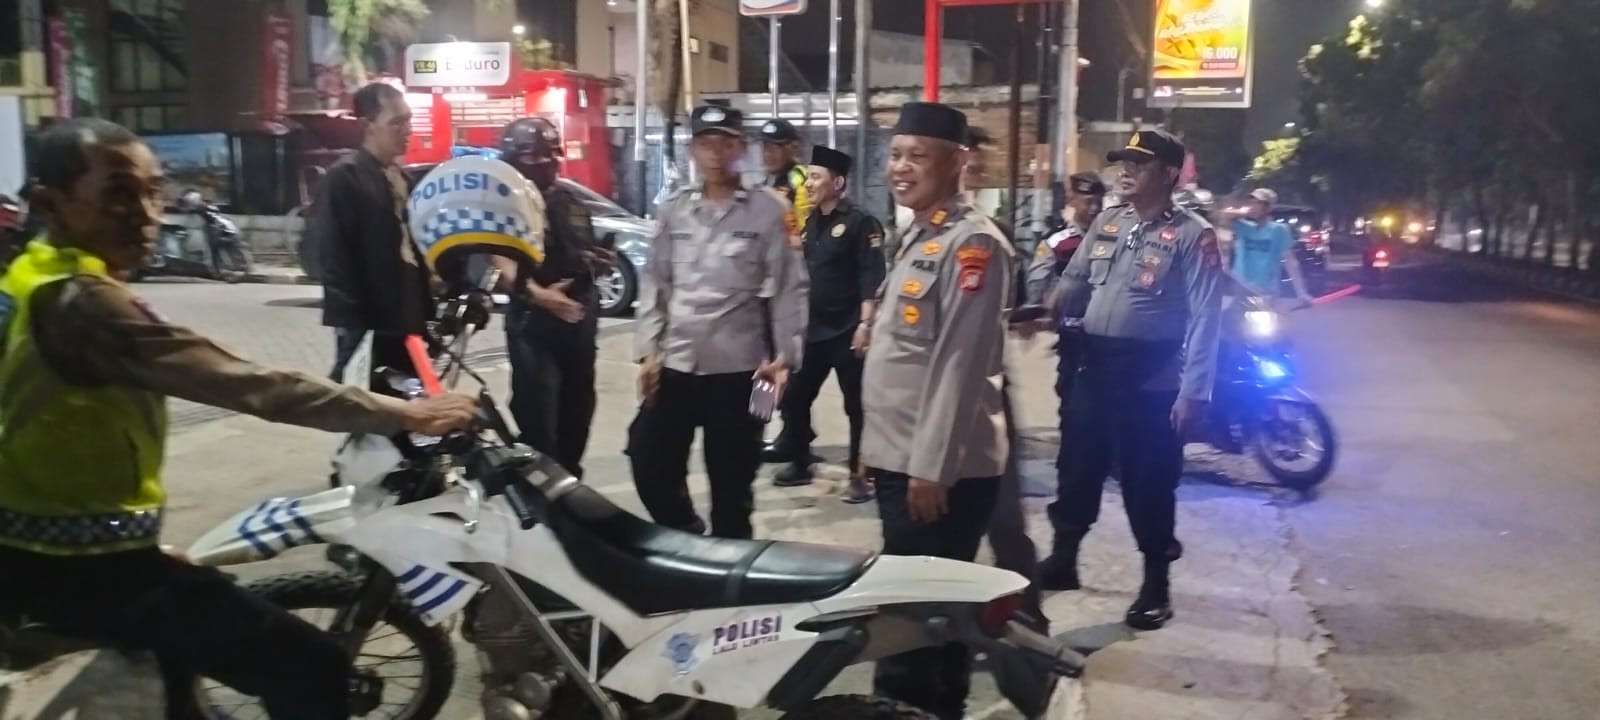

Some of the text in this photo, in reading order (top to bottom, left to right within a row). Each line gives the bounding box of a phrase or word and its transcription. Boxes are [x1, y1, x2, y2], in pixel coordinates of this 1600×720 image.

[446, 57, 500, 70] Eduro
[411, 172, 489, 210] POLISI
[713, 615, 782, 646] POLISI
